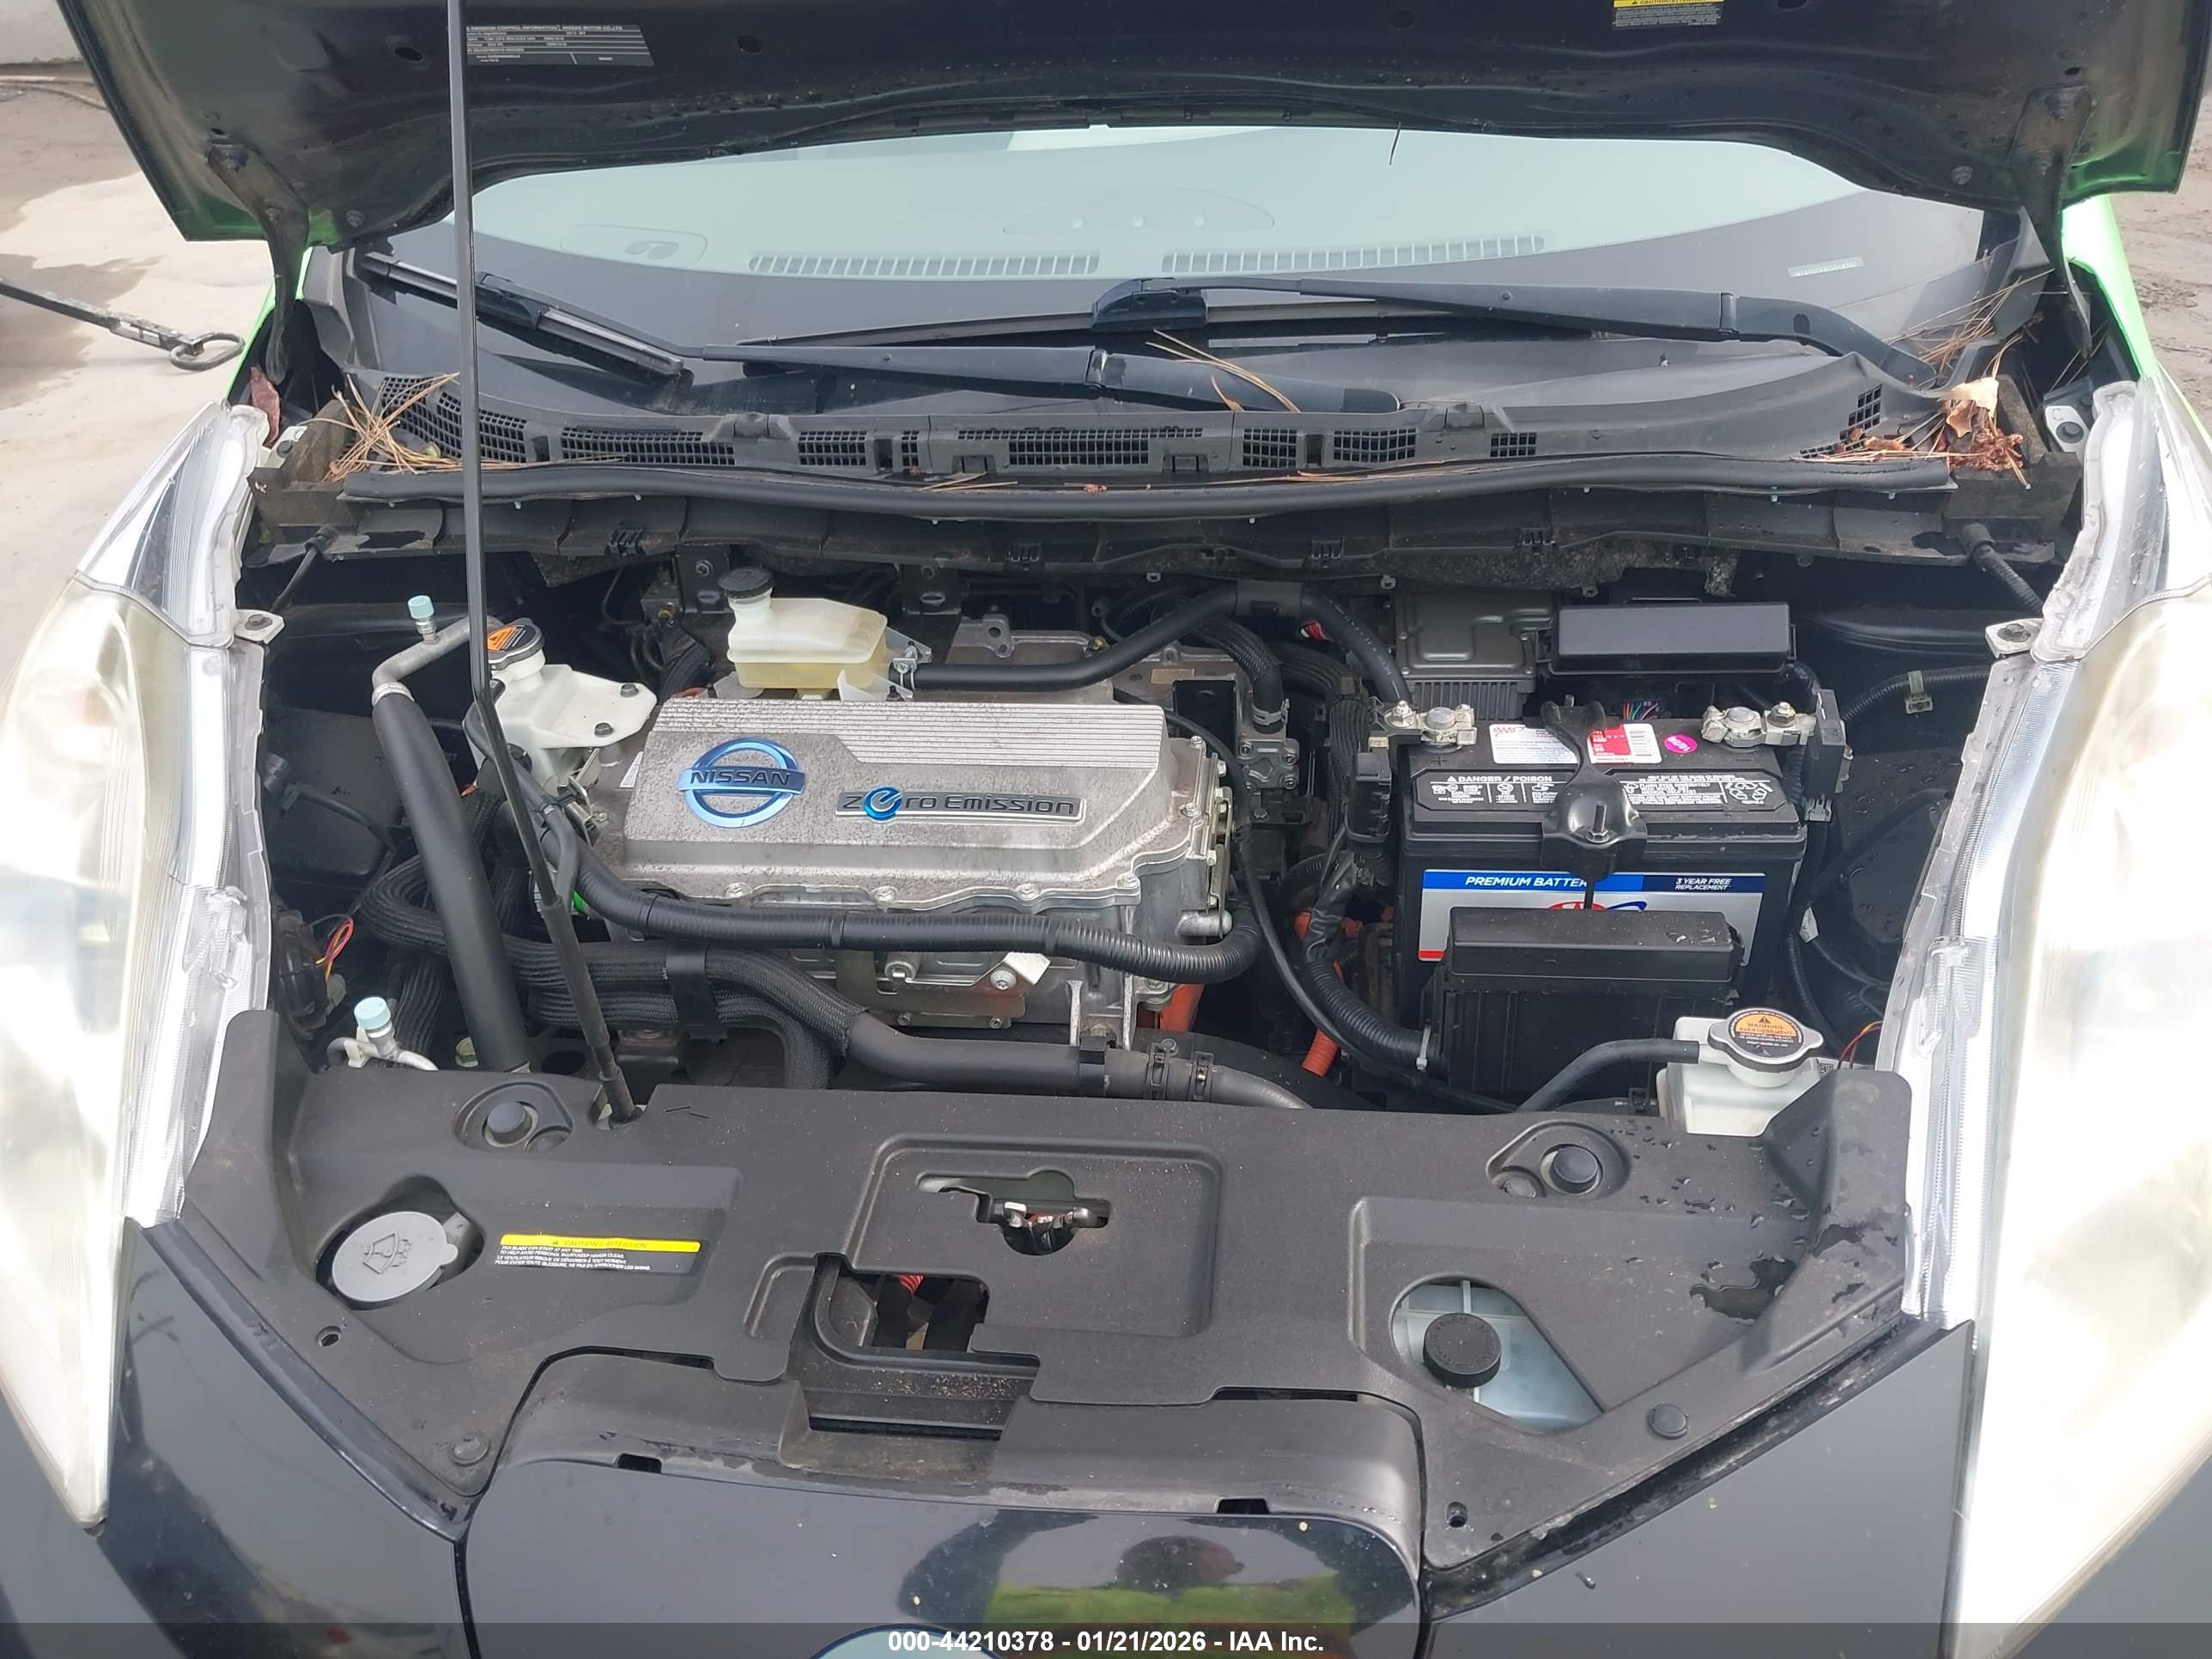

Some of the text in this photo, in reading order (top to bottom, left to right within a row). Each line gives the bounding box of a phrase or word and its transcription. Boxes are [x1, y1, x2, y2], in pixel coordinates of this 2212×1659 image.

[690, 770, 791, 787] NISSAN
[944, 793, 1075, 815] Emission
[1465, 876, 1588, 888] PREMIUM BATTER
[605, 1241, 647, 1249] ATTENTION
